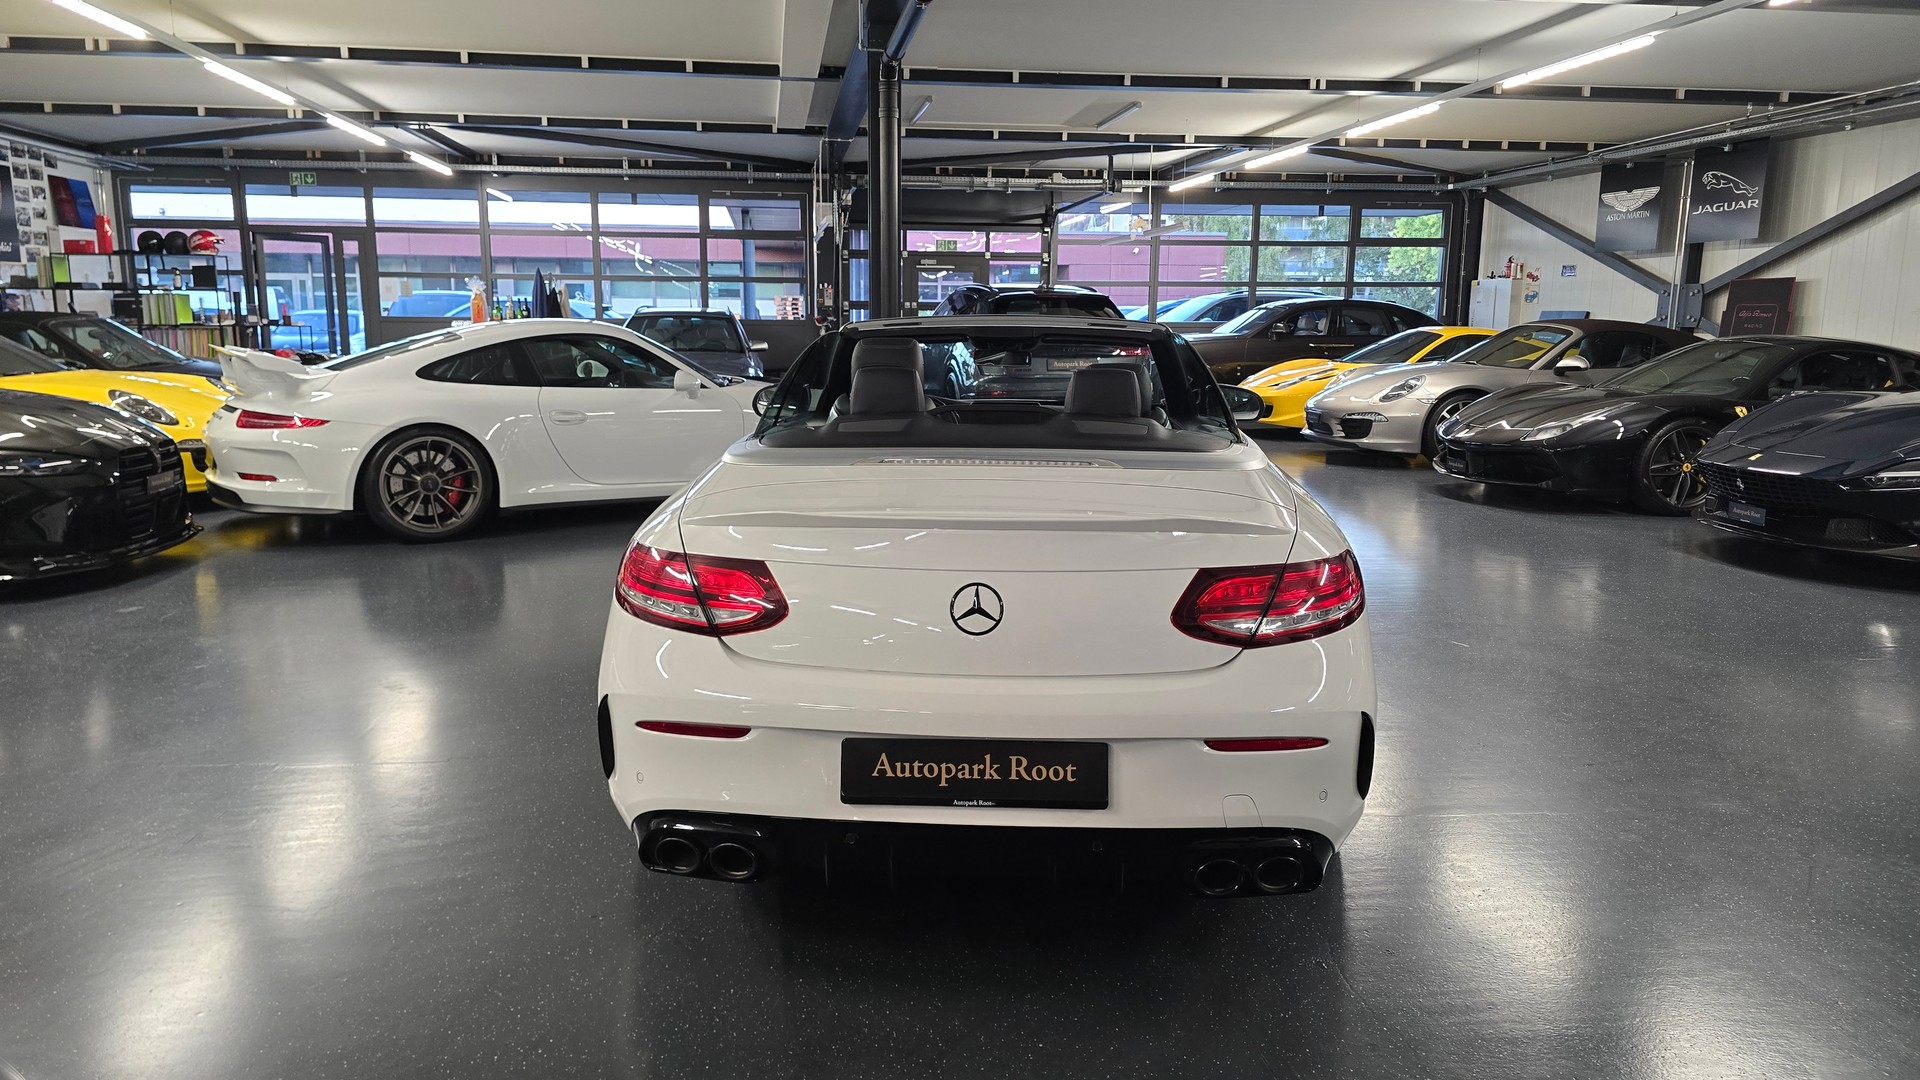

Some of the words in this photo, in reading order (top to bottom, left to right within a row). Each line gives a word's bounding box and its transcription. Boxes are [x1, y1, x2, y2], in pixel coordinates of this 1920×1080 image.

[1692, 199, 1759, 215] JAGUAR
[1606, 212, 1626, 222] ASTON
[1627, 210, 1650, 219] MARTIN
[1738, 310, 1751, 319] Alfa
[1752, 309, 1772, 318] Romeo
[1053, 360, 1079, 368] Autopark
[871, 752, 1002, 787] Autopark
[1009, 755, 1077, 782] Root
[952, 799, 978, 807] Autopark
